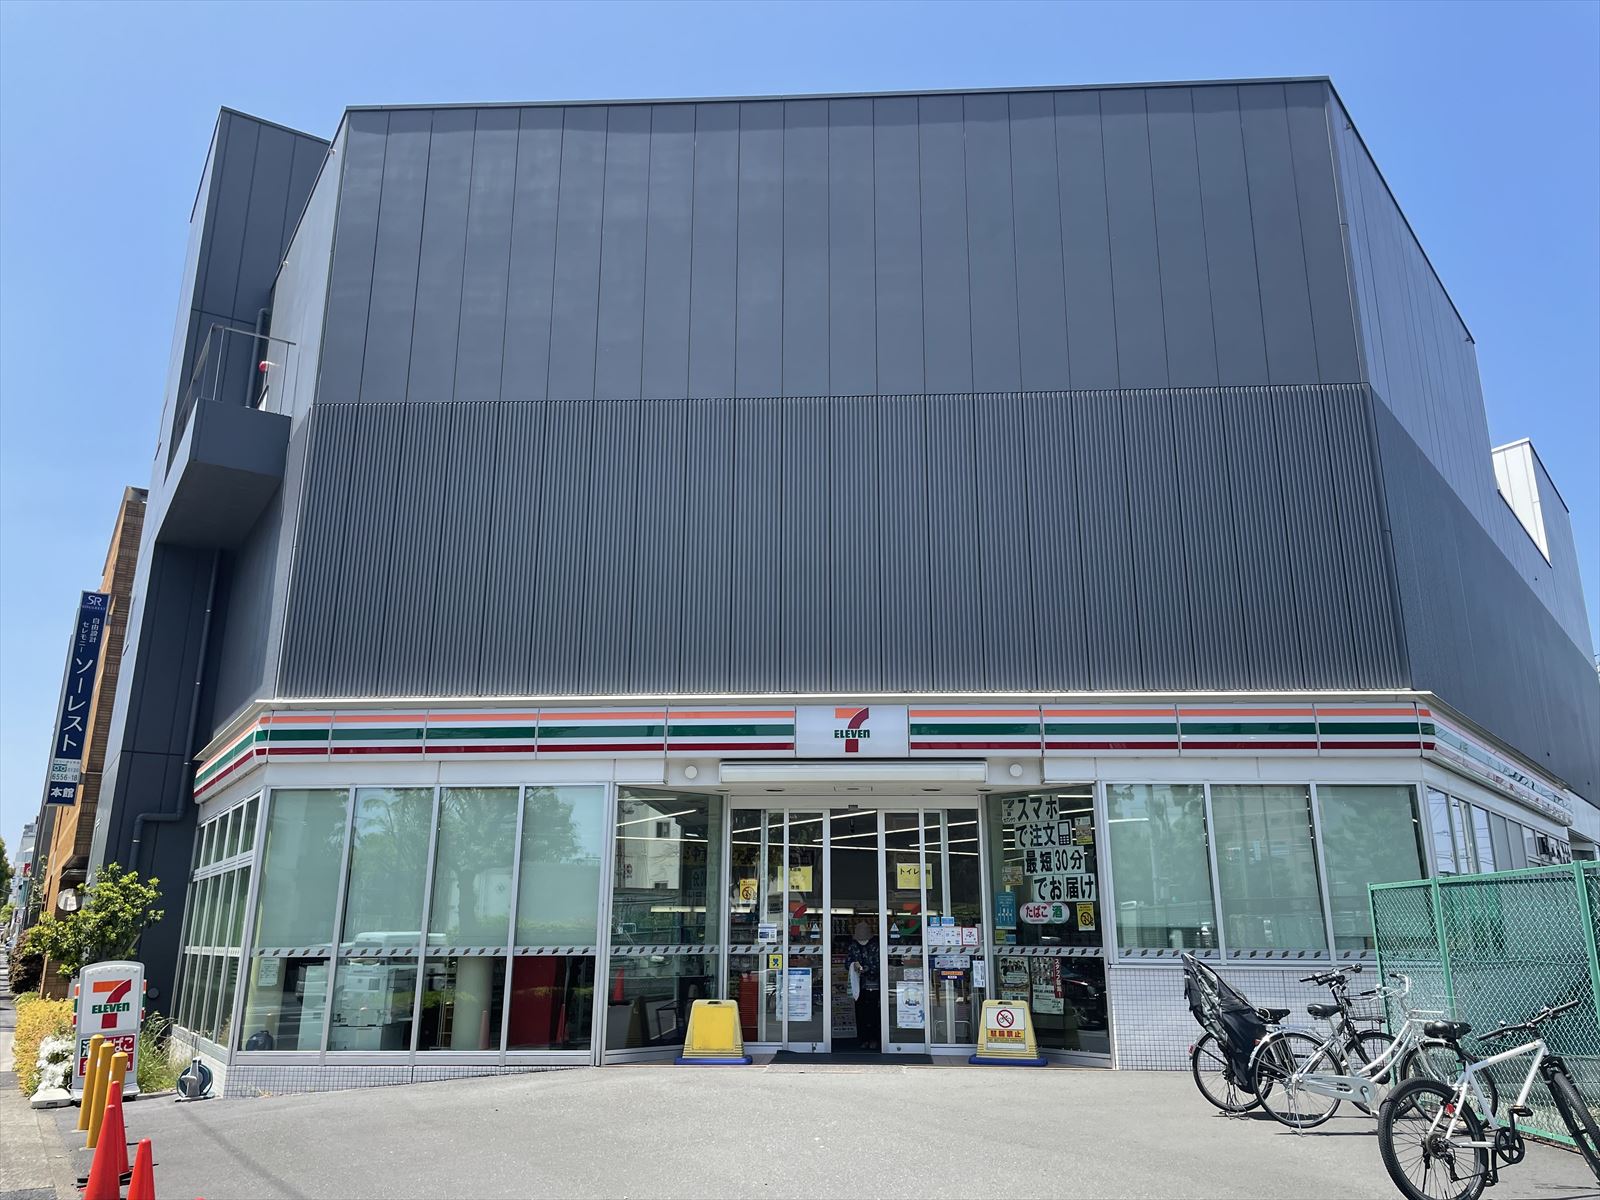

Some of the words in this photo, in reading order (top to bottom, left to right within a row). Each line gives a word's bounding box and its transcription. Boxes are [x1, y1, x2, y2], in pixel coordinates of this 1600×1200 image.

[87, 595, 102, 606] SR
[79, 621, 90, 653] セレモニー
[62, 657, 94, 752] ソーレスト
[50, 786, 75, 798] 本館
[1017, 795, 1058, 821] スマホ
[1015, 822, 1057, 848] で注文
[1025, 849, 1084, 874] 最短30分
[1033, 875, 1094, 901] でお届け
[1025, 905, 1049, 918] たばこ
[1052, 905, 1063, 918] 酒
